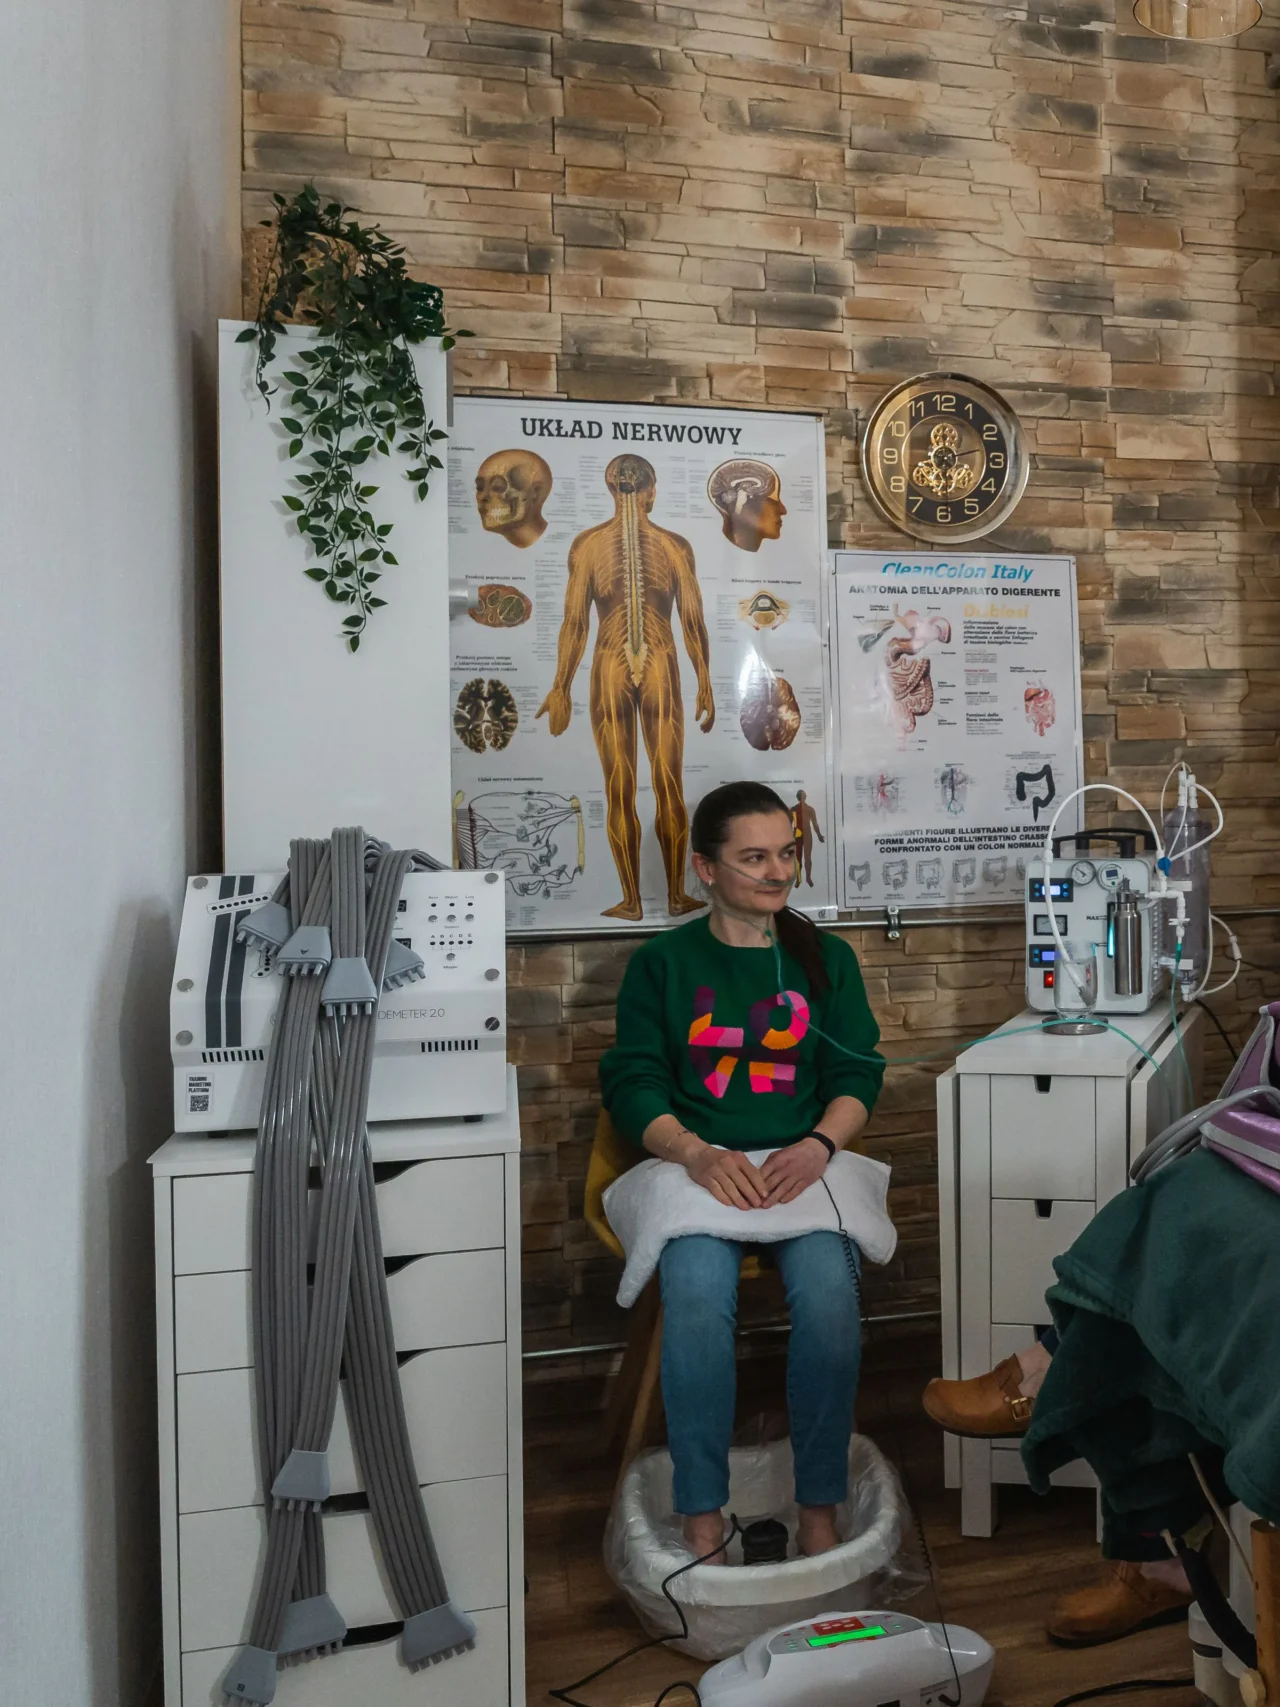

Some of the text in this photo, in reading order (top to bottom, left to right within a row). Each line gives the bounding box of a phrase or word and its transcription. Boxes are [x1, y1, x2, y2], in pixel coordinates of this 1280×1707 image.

[907, 401, 924, 417] 11
[932, 394, 956, 412] 12
[964, 403, 973, 420] 1
[520, 417, 743, 446] UKŁAD NERWOWY
[888, 421, 906, 437] 10
[983, 423, 998, 441] 2
[883, 448, 898, 464] 9
[989, 452, 1004, 469] 3
[890, 476, 905, 492] 8
[981, 478, 996, 494] 4
[908, 496, 923, 513] 7
[964, 498, 979, 515] 5
[936, 506, 951, 522] 6
[882, 562, 1034, 583] CleanColon Italy
[911, 585, 999, 596] DELL'APPARATO
[1002, 587, 1061, 597] DIGERENTE
[926, 828, 956, 836] FIGURE
[958, 827, 1009, 835] ILLUSTRANO
[953, 835, 1017, 843] DELL'INTESTINO
[879, 845, 941, 853] CONFRONTATO
[944, 844, 961, 852] CON
[1008, 841, 1045, 849] NORMALE
[377, 1009, 427, 1020] DEMETER
